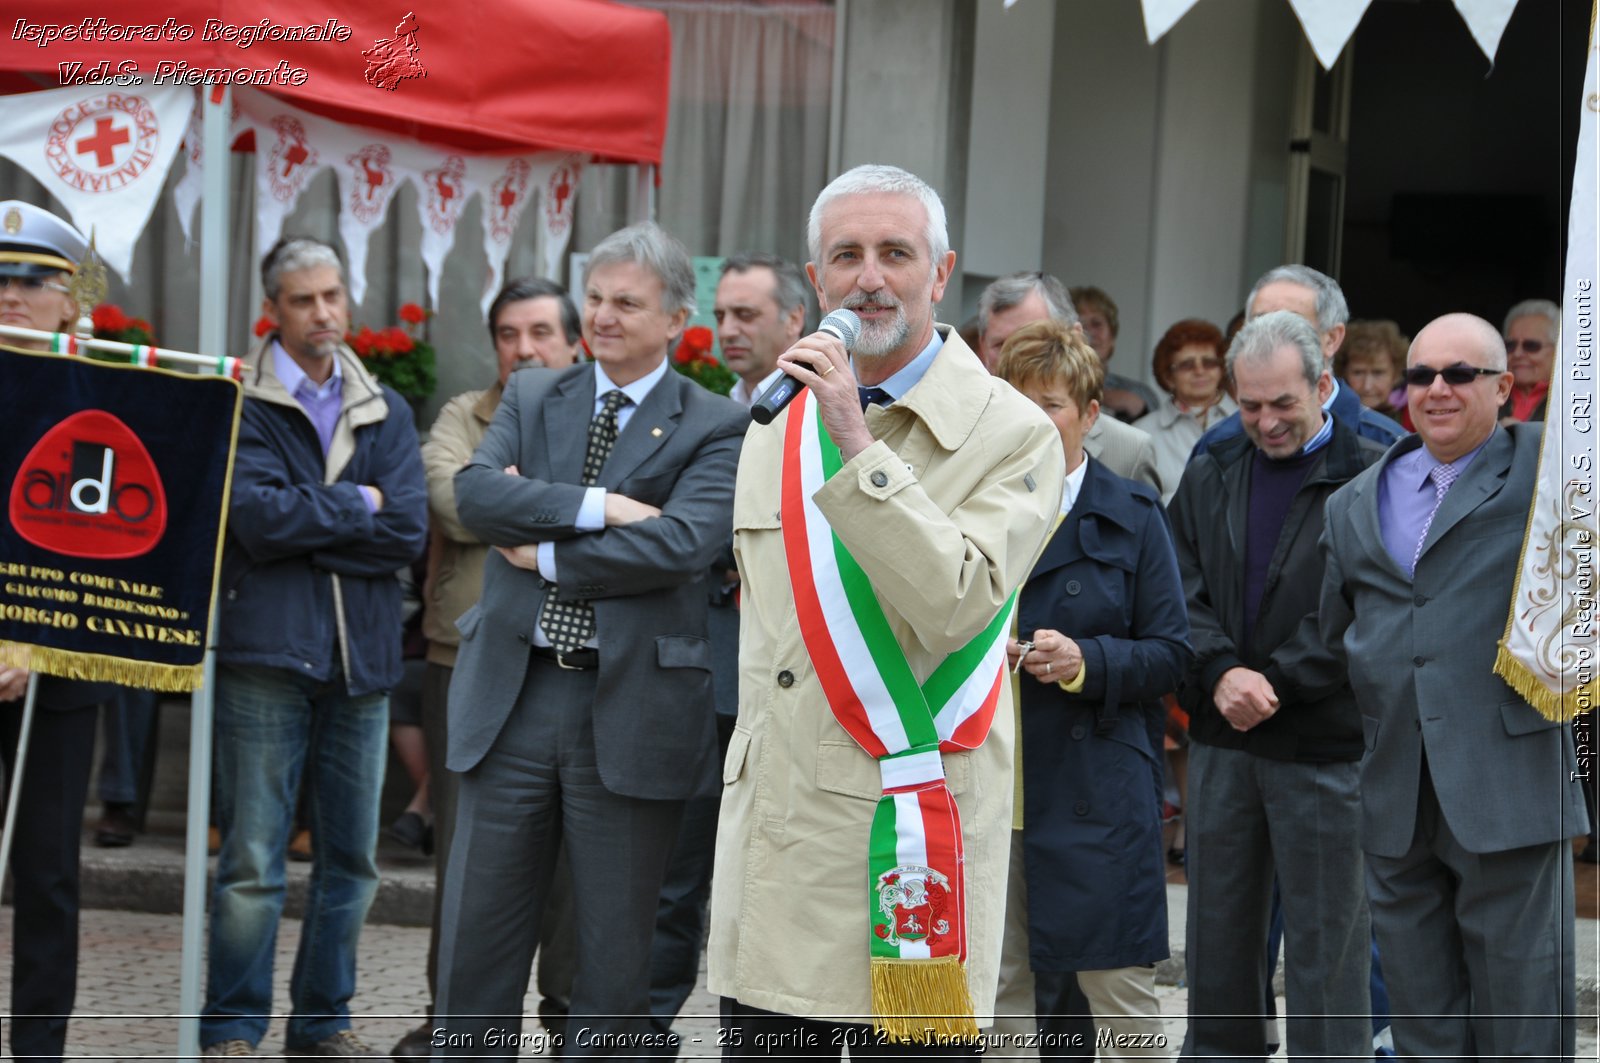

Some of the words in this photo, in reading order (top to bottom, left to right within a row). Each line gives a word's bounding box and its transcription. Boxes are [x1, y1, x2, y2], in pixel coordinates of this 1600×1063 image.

[23, 447, 154, 522] aido
[5, 582, 78, 603] GIACOMO
[69, 571, 164, 600] COMUNALE
[86, 615, 201, 646] CANAVESE
